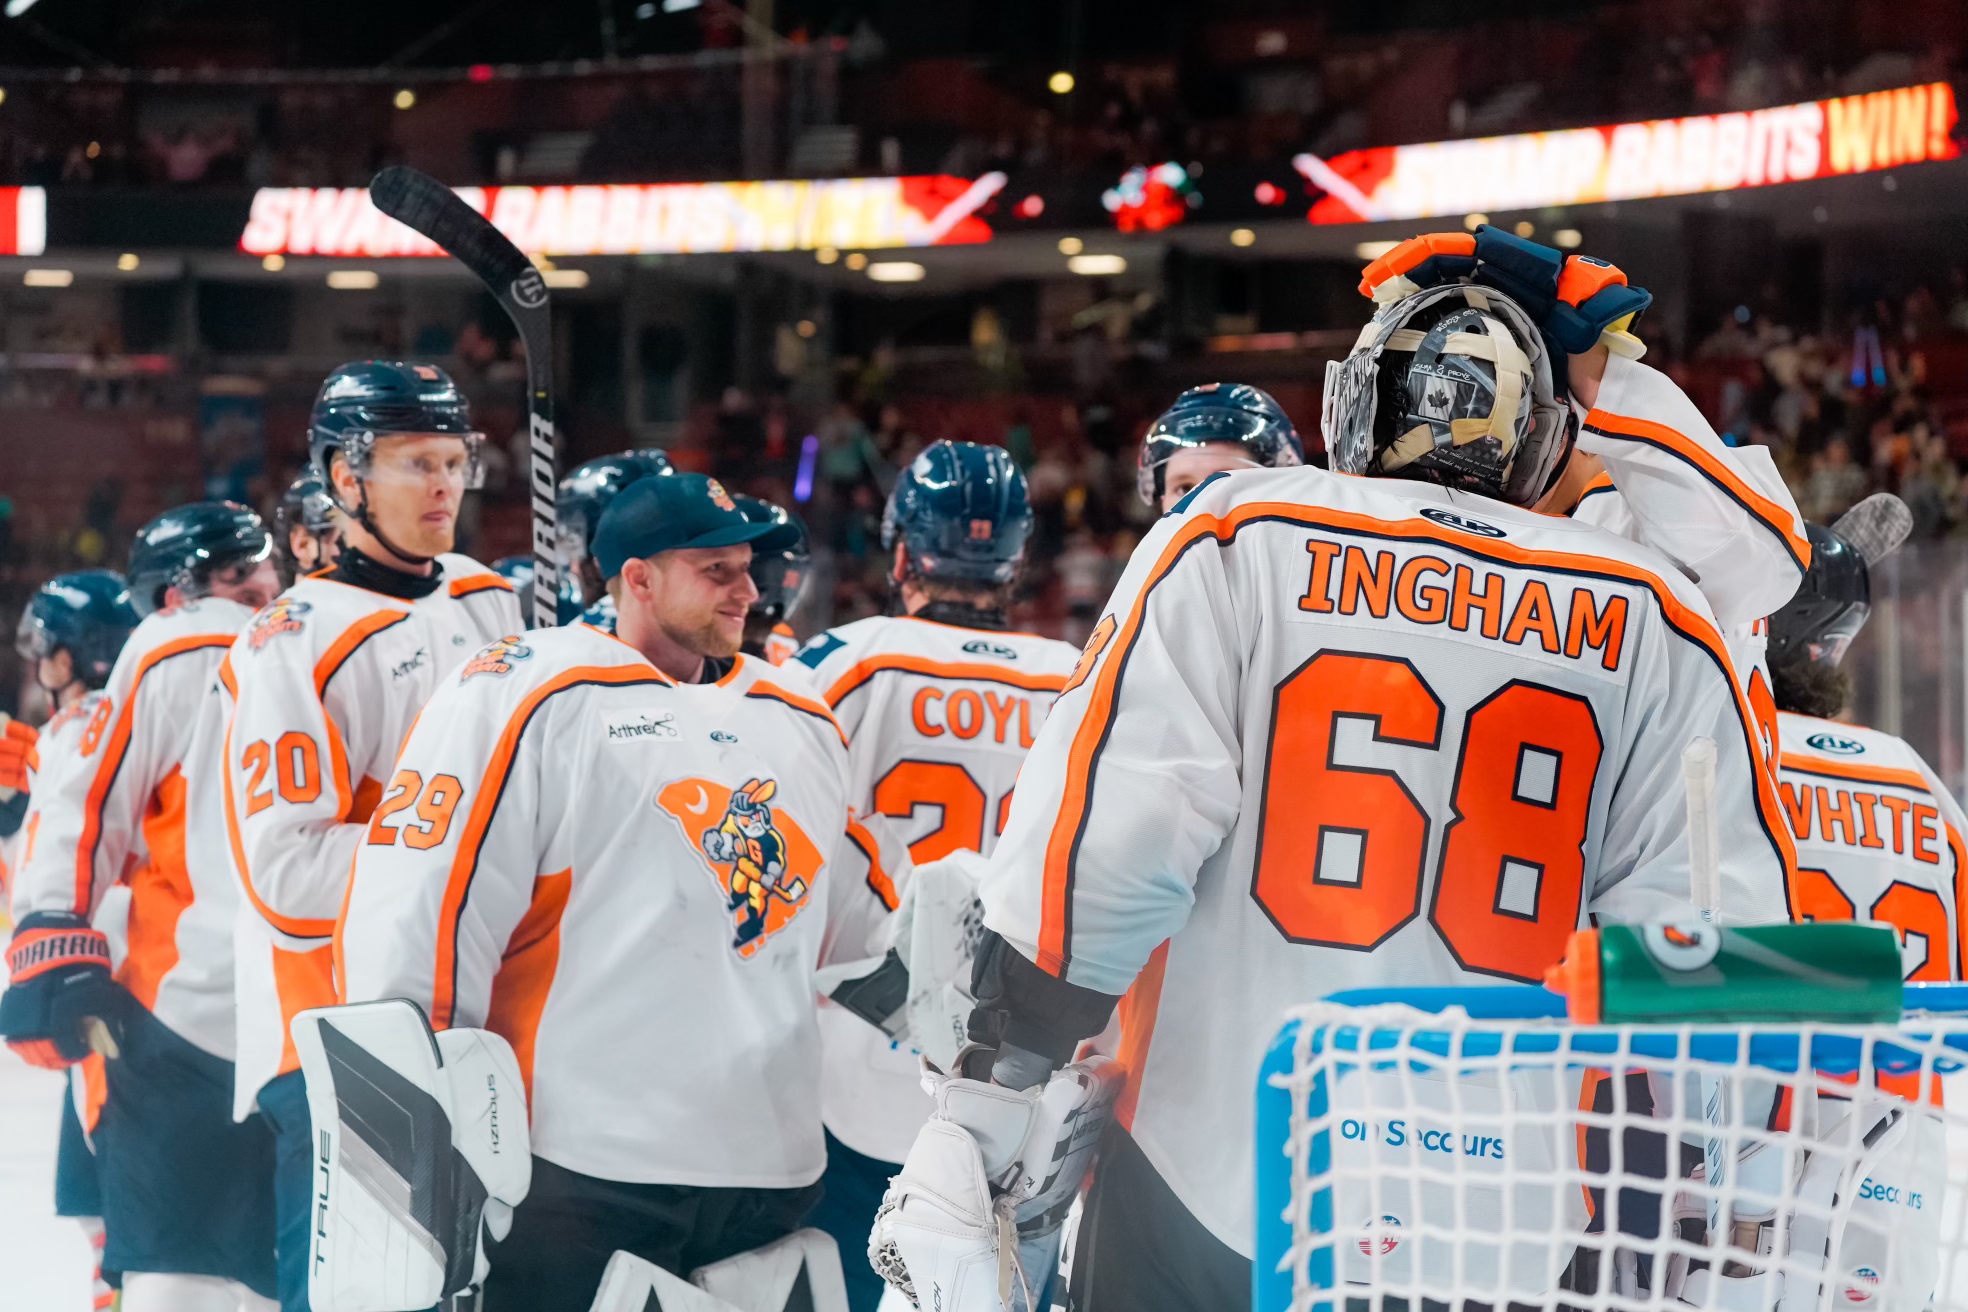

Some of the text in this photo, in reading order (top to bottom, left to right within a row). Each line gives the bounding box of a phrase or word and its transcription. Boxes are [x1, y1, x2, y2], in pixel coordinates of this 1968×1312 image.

[1607, 102, 1824, 195] RABBITS
[1827, 83, 1948, 172] WIN!
[242, 186, 488, 254] SWA
[530, 411, 559, 630] ARRIOR
[1296, 538, 1630, 673] INGHAM
[911, 686, 1054, 749] COYL
[242, 730, 321, 818] 20
[366, 769, 464, 850] 29
[1248, 647, 1605, 984] 68
[1781, 781, 1940, 865] WHITE
[11, 934, 110, 975] WARRIO
[314, 1128, 331, 1279] TRUE
